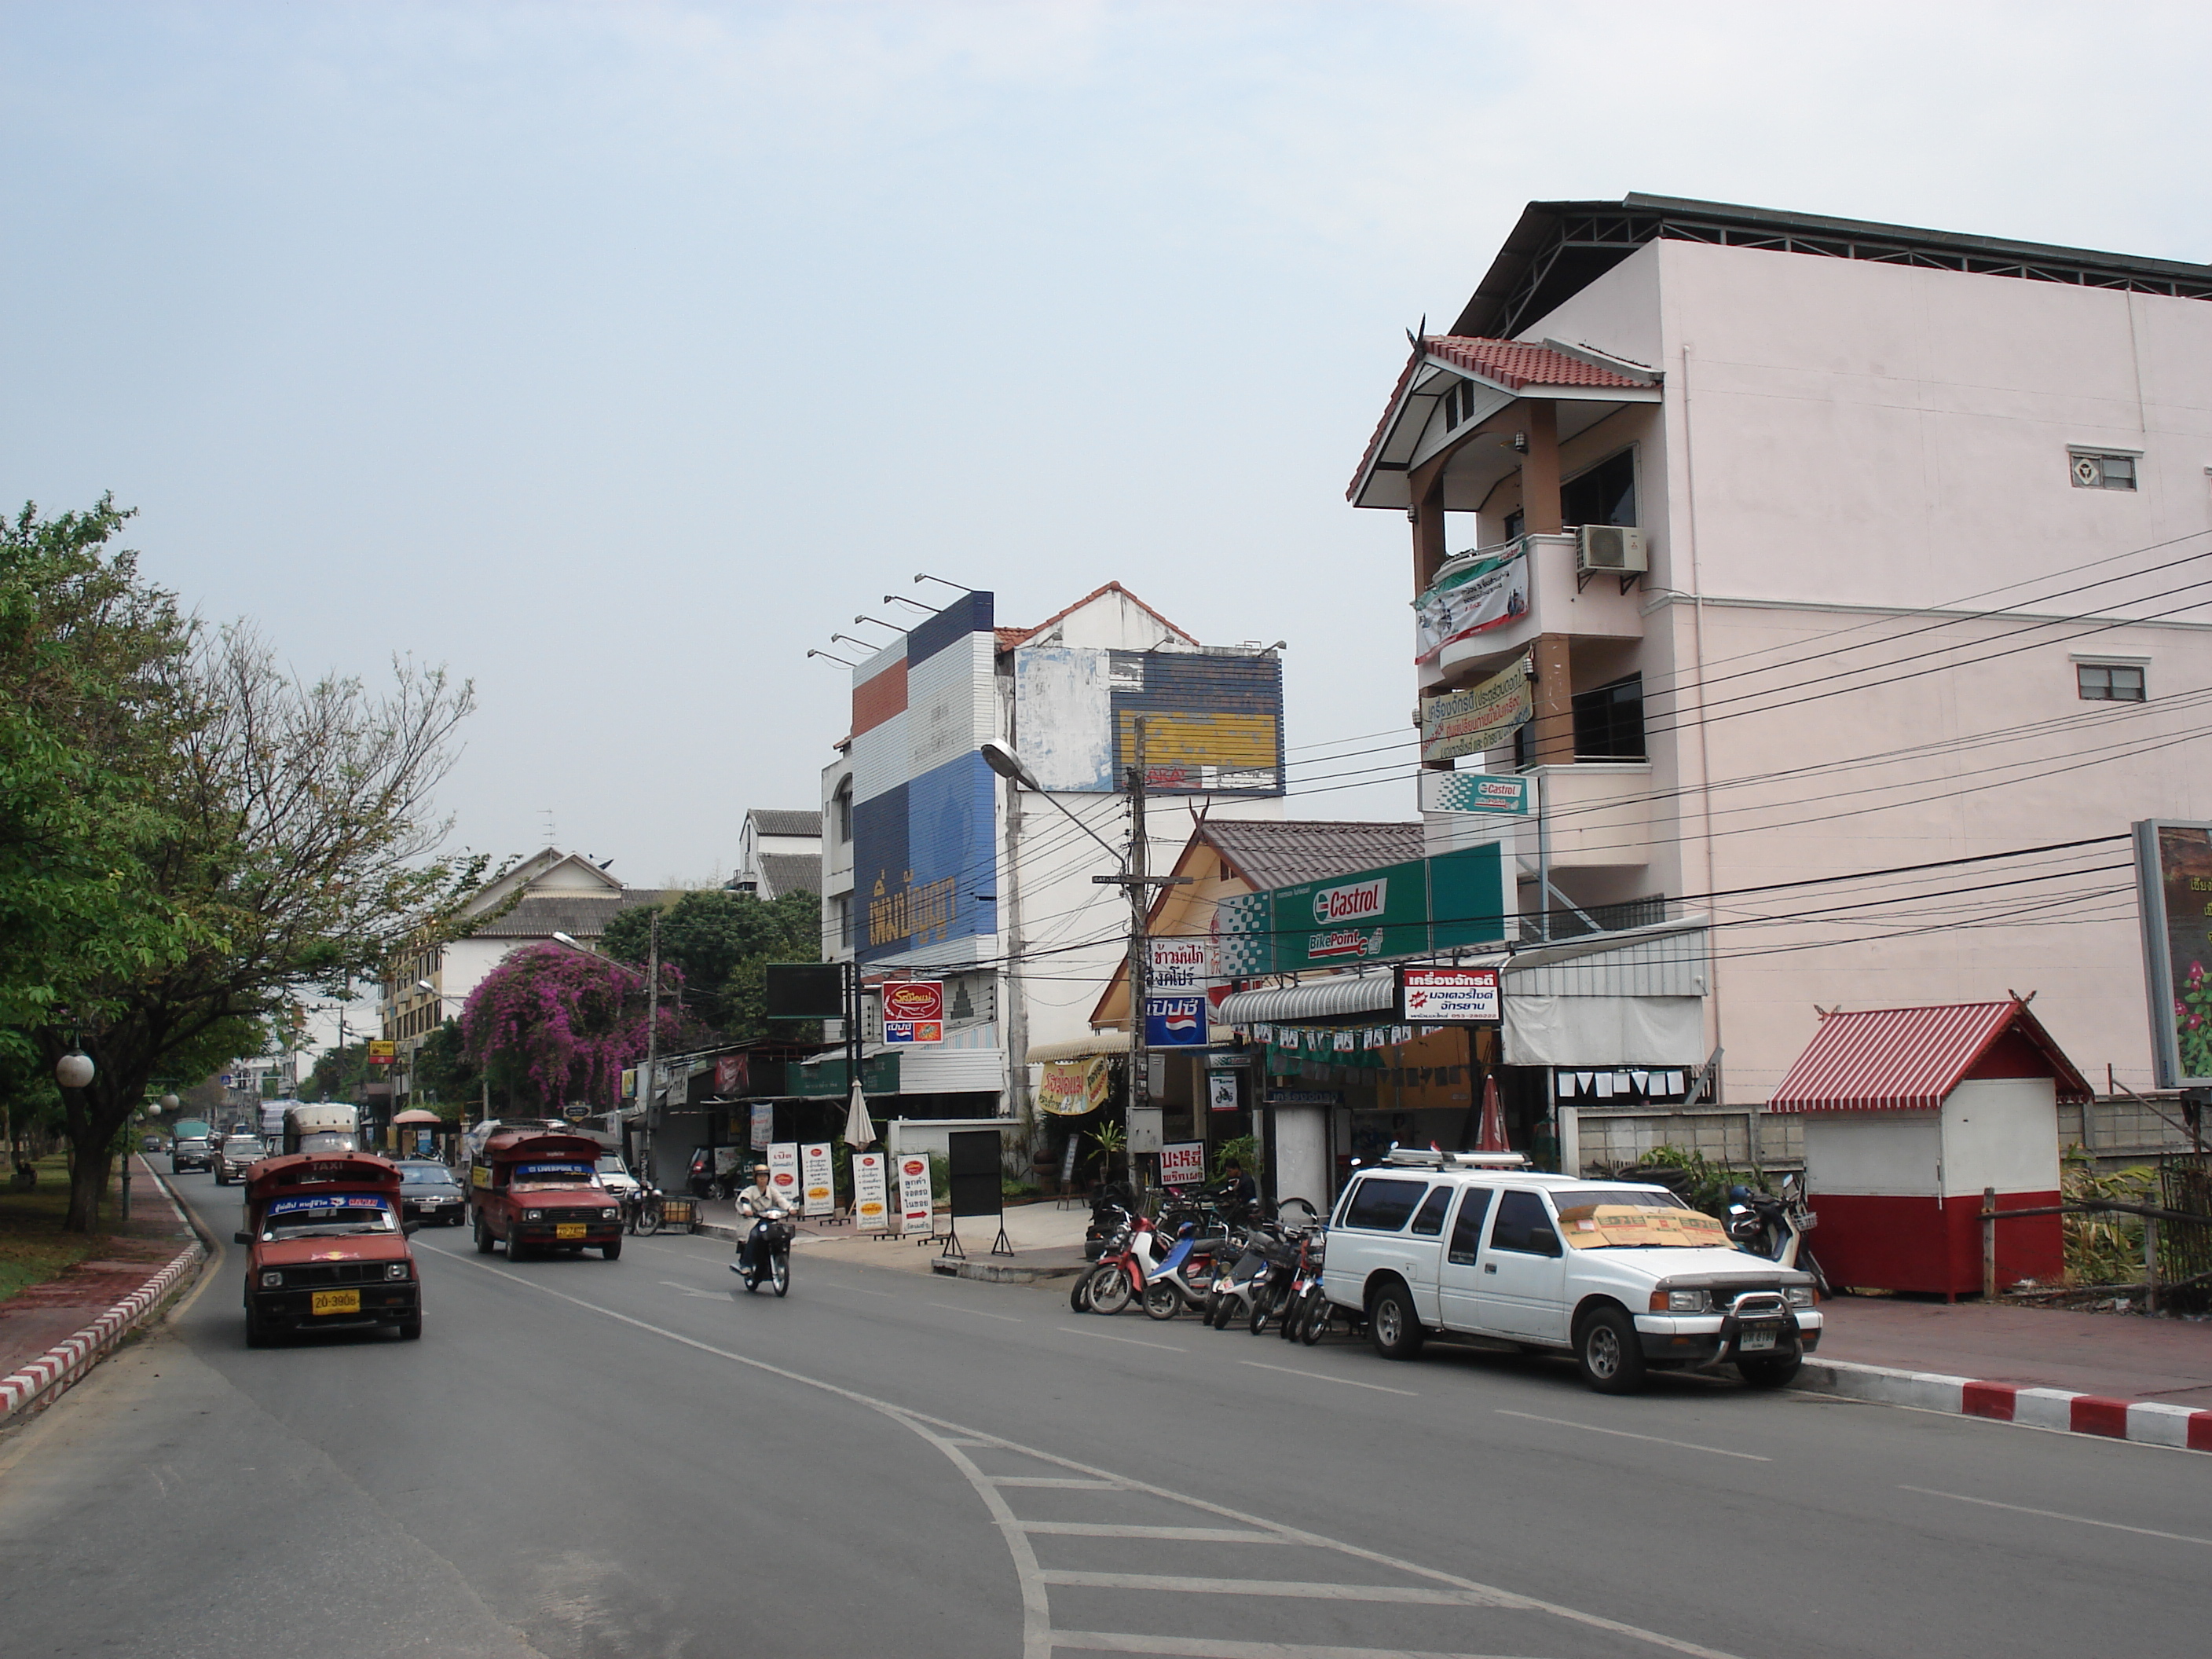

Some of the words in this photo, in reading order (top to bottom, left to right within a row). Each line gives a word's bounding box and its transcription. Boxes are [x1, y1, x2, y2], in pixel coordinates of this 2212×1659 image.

[1488, 784, 1516, 795] Castrol
[1330, 884, 1378, 917] Castrol
[1309, 930, 1359, 950] BikePoint
[1154, 944, 1203, 965] ข้าวมันไก่
[1408, 972, 1494, 986] เครื่องจักรดี
[1441, 1000, 1485, 1010] จักรยาน
[1044, 1064, 1084, 1095] รสมือแม่
[1162, 1144, 1202, 1169] บะหมี่
[310, 1162, 343, 1171] TAXI
[905, 1177, 926, 1189] ลูกค้า
[905, 1188, 928, 1198] จอดรถ
[904, 1199, 929, 1209] ในซอย
